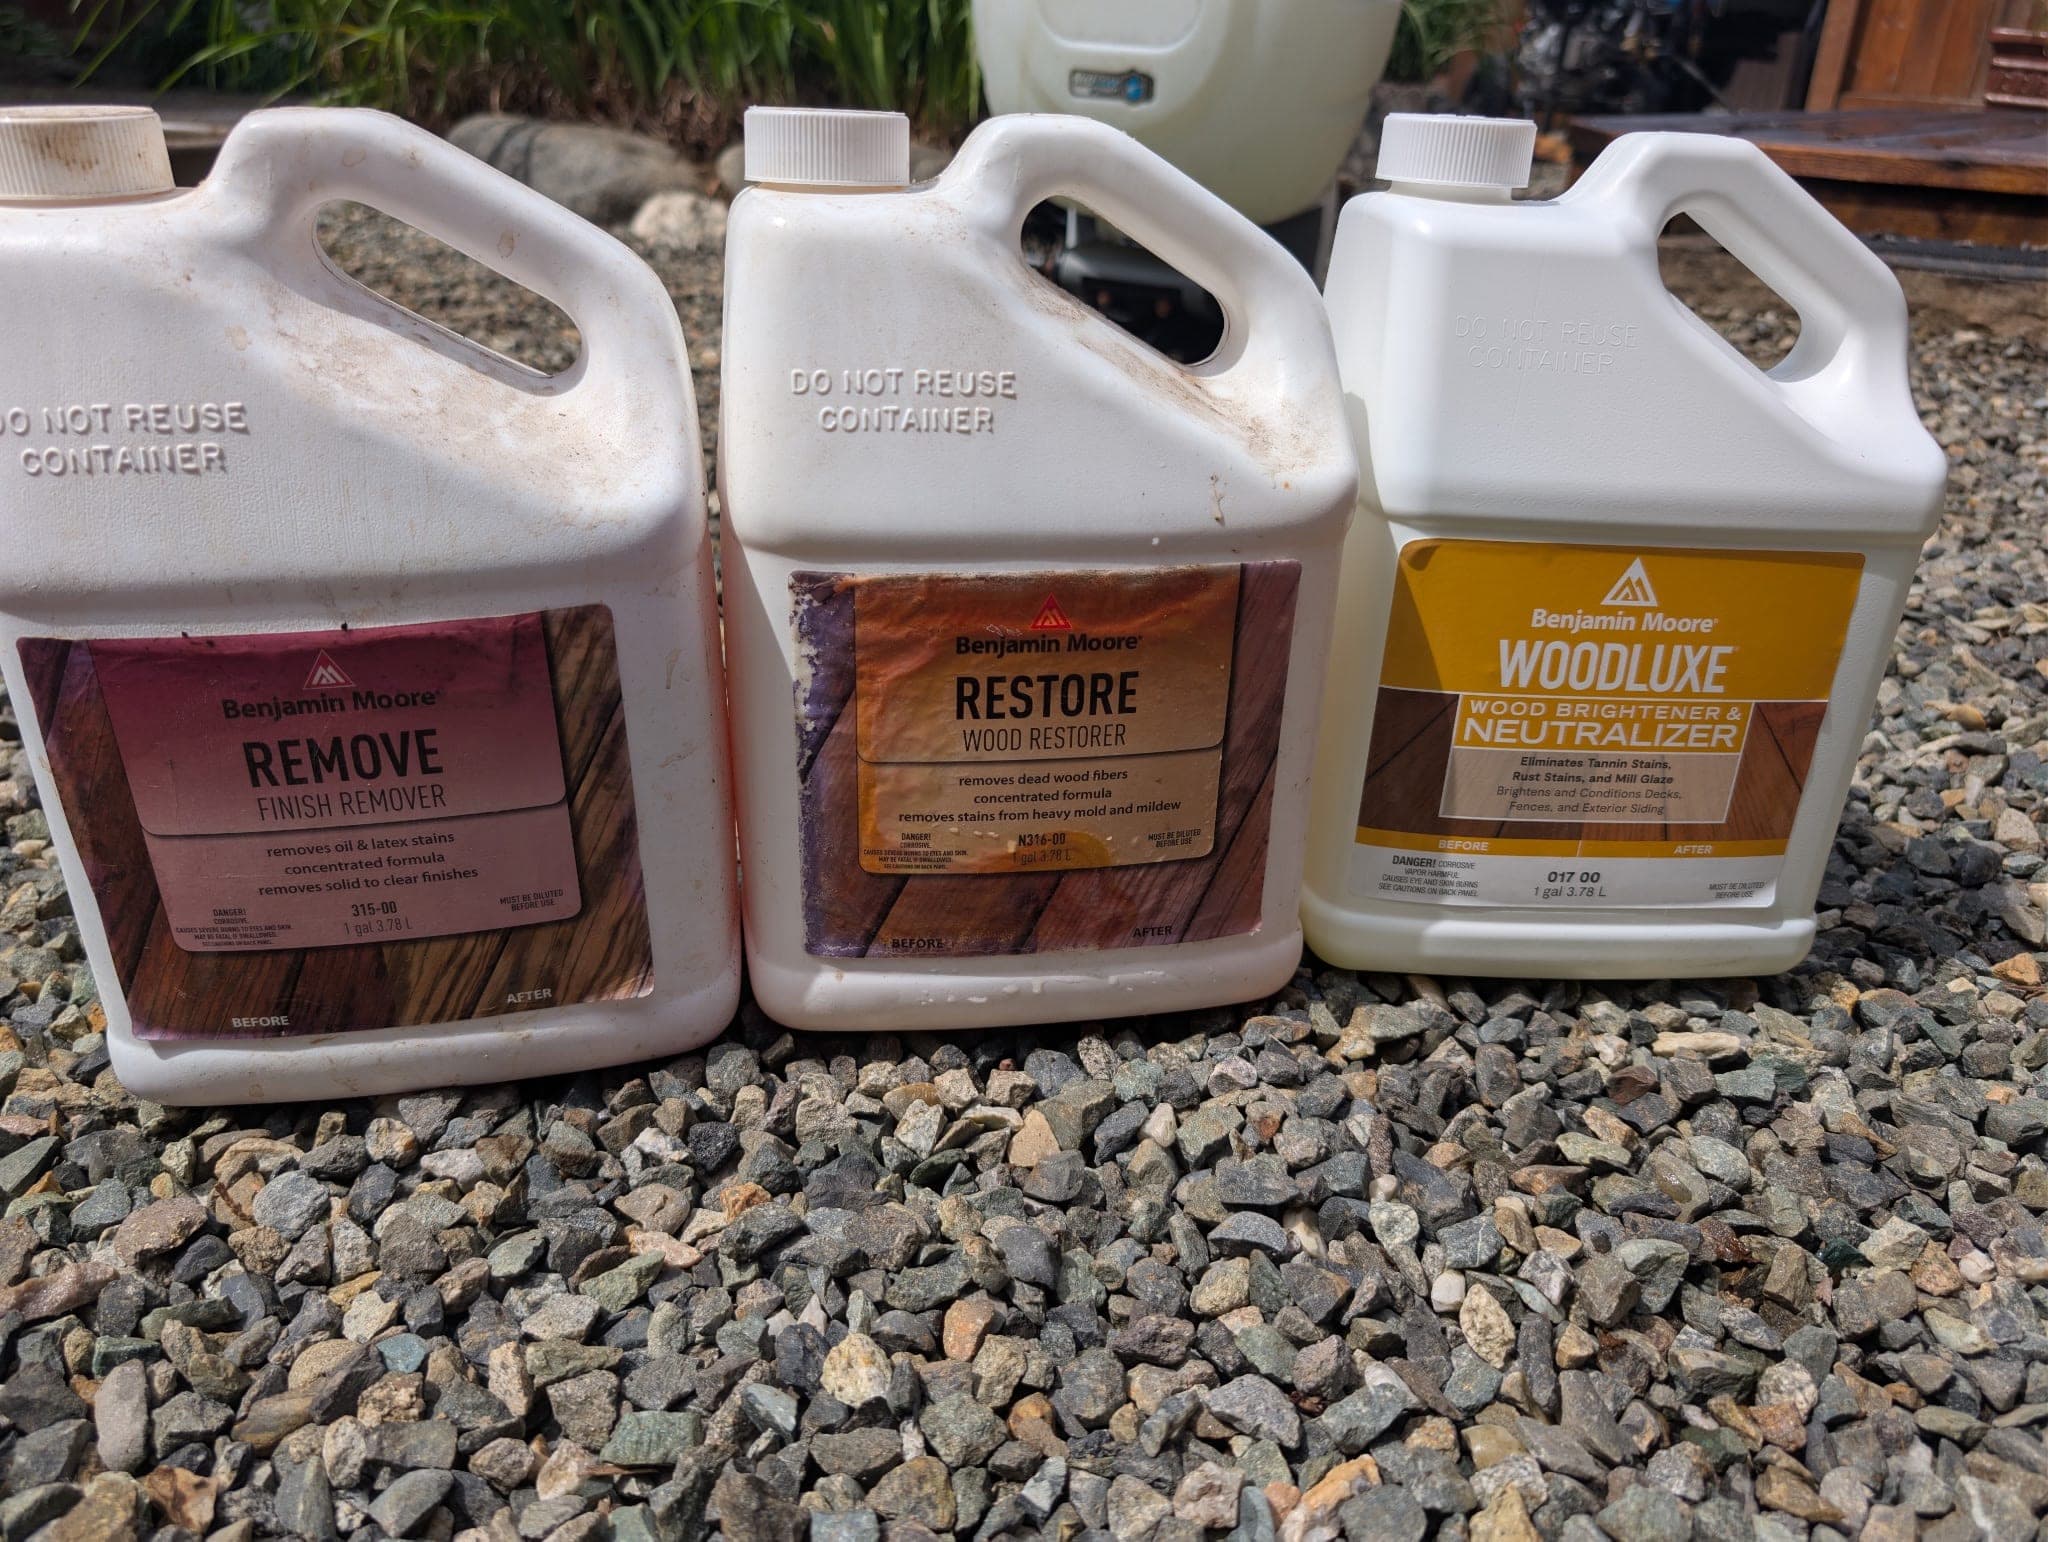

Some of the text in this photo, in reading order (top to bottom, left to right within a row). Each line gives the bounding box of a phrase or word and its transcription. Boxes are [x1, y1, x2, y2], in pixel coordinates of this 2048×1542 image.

[1455, 314, 1640, 348] DO NOT REUSE
[1468, 346, 1617, 376] CONTAINER
[791, 368, 1017, 400] DO NOT REUSE
[0, 402, 249, 435] O NOT REUSE
[819, 405, 993, 435] CONTAINER
[21, 443, 226, 476] CONTAINER
[1531, 608, 1713, 634] Benjamin Moore
[956, 633, 1138, 658] Benjamin Moore
[1500, 639, 1734, 693] WOODLUXE
[956, 671, 1139, 720] RESTORE
[222, 690, 436, 721] Benjamin Moore
[1471, 700, 1741, 721] WOOD BRIGHTENER &
[963, 723, 1126, 752] WOOD RESTORER
[1464, 718, 1737, 747] NEUTRALIZER
[243, 729, 443, 788] REMOVE
[1520, 756, 1583, 768] Eliminates
[1588, 758, 1627, 769] Tannin
[959, 769, 1128, 787] removes dead wood fibers
[1512, 771, 1674, 784] Rust Stains, and Mill Glaze
[974, 788, 1112, 804] concentrated formula
[1496, 786, 1681, 800] Brightens and Conditions Decks,
[257, 784, 446, 821] FINISH REMOVER
[1557, 802, 1579, 812] and
[1582, 803, 1627, 813] Exterior
[1630, 803, 1664, 815] Siding
[899, 800, 1181, 822] removes stains from heavy mold and mildew
[901, 833, 931, 841] DANGER!
[1018, 833, 1066, 846] N316-00
[1148, 832, 1166, 841] MUST
[1176, 829, 1201, 838] DILUTED
[1181, 837, 1192, 845] USE
[267, 832, 454, 857] removes oil & latex stains
[1438, 840, 1488, 851] BEFORE
[1673, 845, 1712, 855] AFTER
[285, 852, 445, 875] concentrated formula
[1021, 851, 1036, 865] gal
[1040, 850, 1062, 862] 3.78
[1392, 855, 1436, 868] DANGER!
[1404, 868, 1426, 876] VAPOR
[1547, 871, 1601, 883] 017 00
[259, 867, 478, 896] removes solid to clear finishes
[1378, 882, 1392, 890] SEE
[1393, 884, 1426, 894] CAUTIONS
[1427, 887, 1437, 895] ON
[1439, 888, 1457, 896] BACK
[1382, 874, 1478, 888] CAUSES EYE AND SKIN BURNS
[500, 889, 563, 904] MUST BE DILUTED
[1534, 886, 1606, 900] 1 gal 3.78 L
[351, 901, 397, 917] 315-00
[511, 898, 555, 911] BEFORE USE
[344, 917, 412, 936] 1 gal 3.78 L
[1133, 926, 1172, 939] AFTER
[892, 938, 944, 949] BEFORE
[507, 988, 552, 1004] AFTER
[232, 1015, 289, 1028] BEFORE
